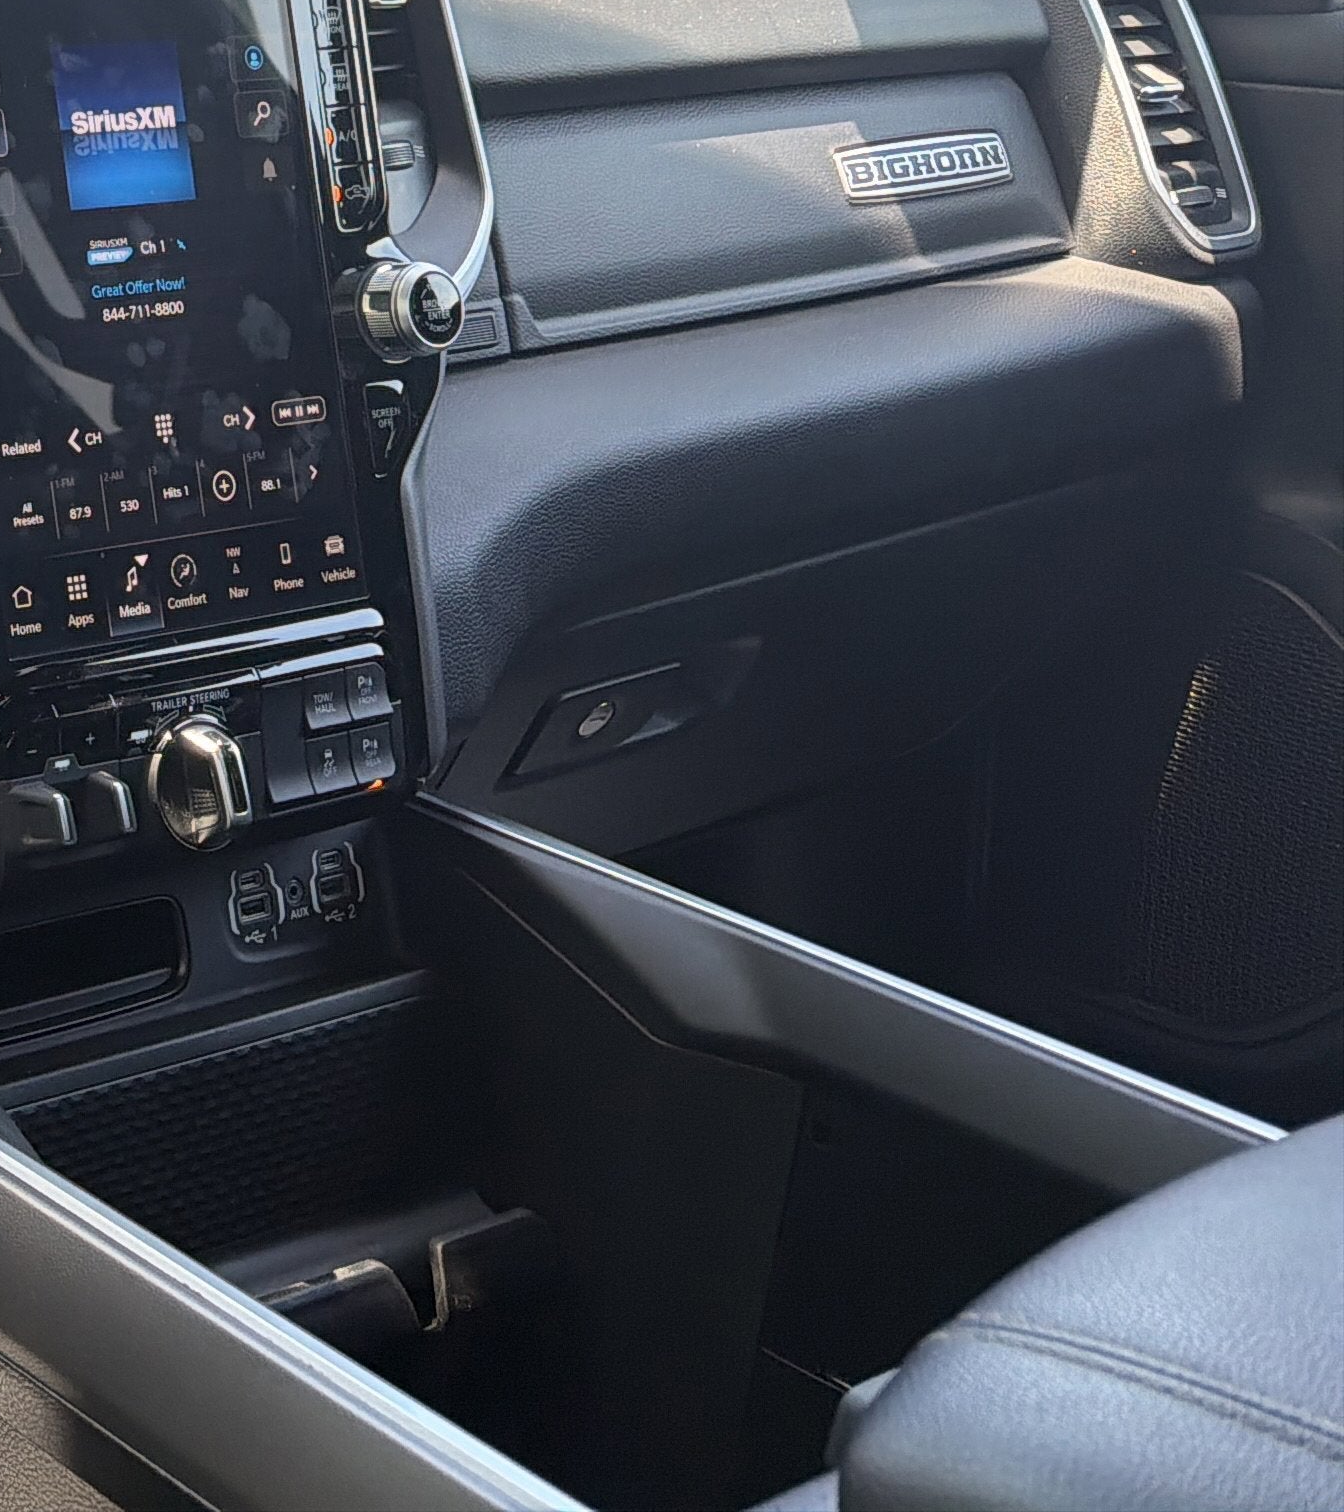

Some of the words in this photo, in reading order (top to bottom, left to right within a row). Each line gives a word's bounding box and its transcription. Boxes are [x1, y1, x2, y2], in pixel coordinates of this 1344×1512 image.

[71, 105, 177, 135] SiriusXM
[845, 143, 1006, 186] BIGHORN
[89, 238, 128, 249] SIRIUSXM
[140, 241, 157, 255] Ch
[91, 249, 129, 262] PREVIEW
[92, 284, 123, 299] Great
[126, 281, 153, 295] Offer
[156, 277, 185, 292] Now!
[102, 300, 185, 322] 844-711-8800
[371, 406, 401, 419] SCREEN
[223, 413, 240, 427] CH
[84, 432, 103, 446] CH
[1, 439, 42, 457] Related
[261, 478, 282, 492] 88.1
[163, 487, 183, 500] Hits
[184, 485, 190, 497] 1
[69, 506, 92, 520] 87.9
[120, 499, 140, 513] 530
[13, 514, 44, 528] Presets
[321, 566, 356, 584] Vehicle
[273, 577, 305, 591] Phone
[229, 586, 249, 600] Nav
[167, 593, 208, 610] Comfort
[118, 602, 152, 619] Media
[68, 612, 95, 628] Apps
[10, 620, 43, 637] Home
[150, 696, 188, 712] TRAILER
[189, 688, 230, 705] STEERING
[313, 691, 333, 704] TOW/
[314, 703, 336, 714] HAUL
[290, 906, 310, 920] AUX
[347, 903, 357, 919] 2
